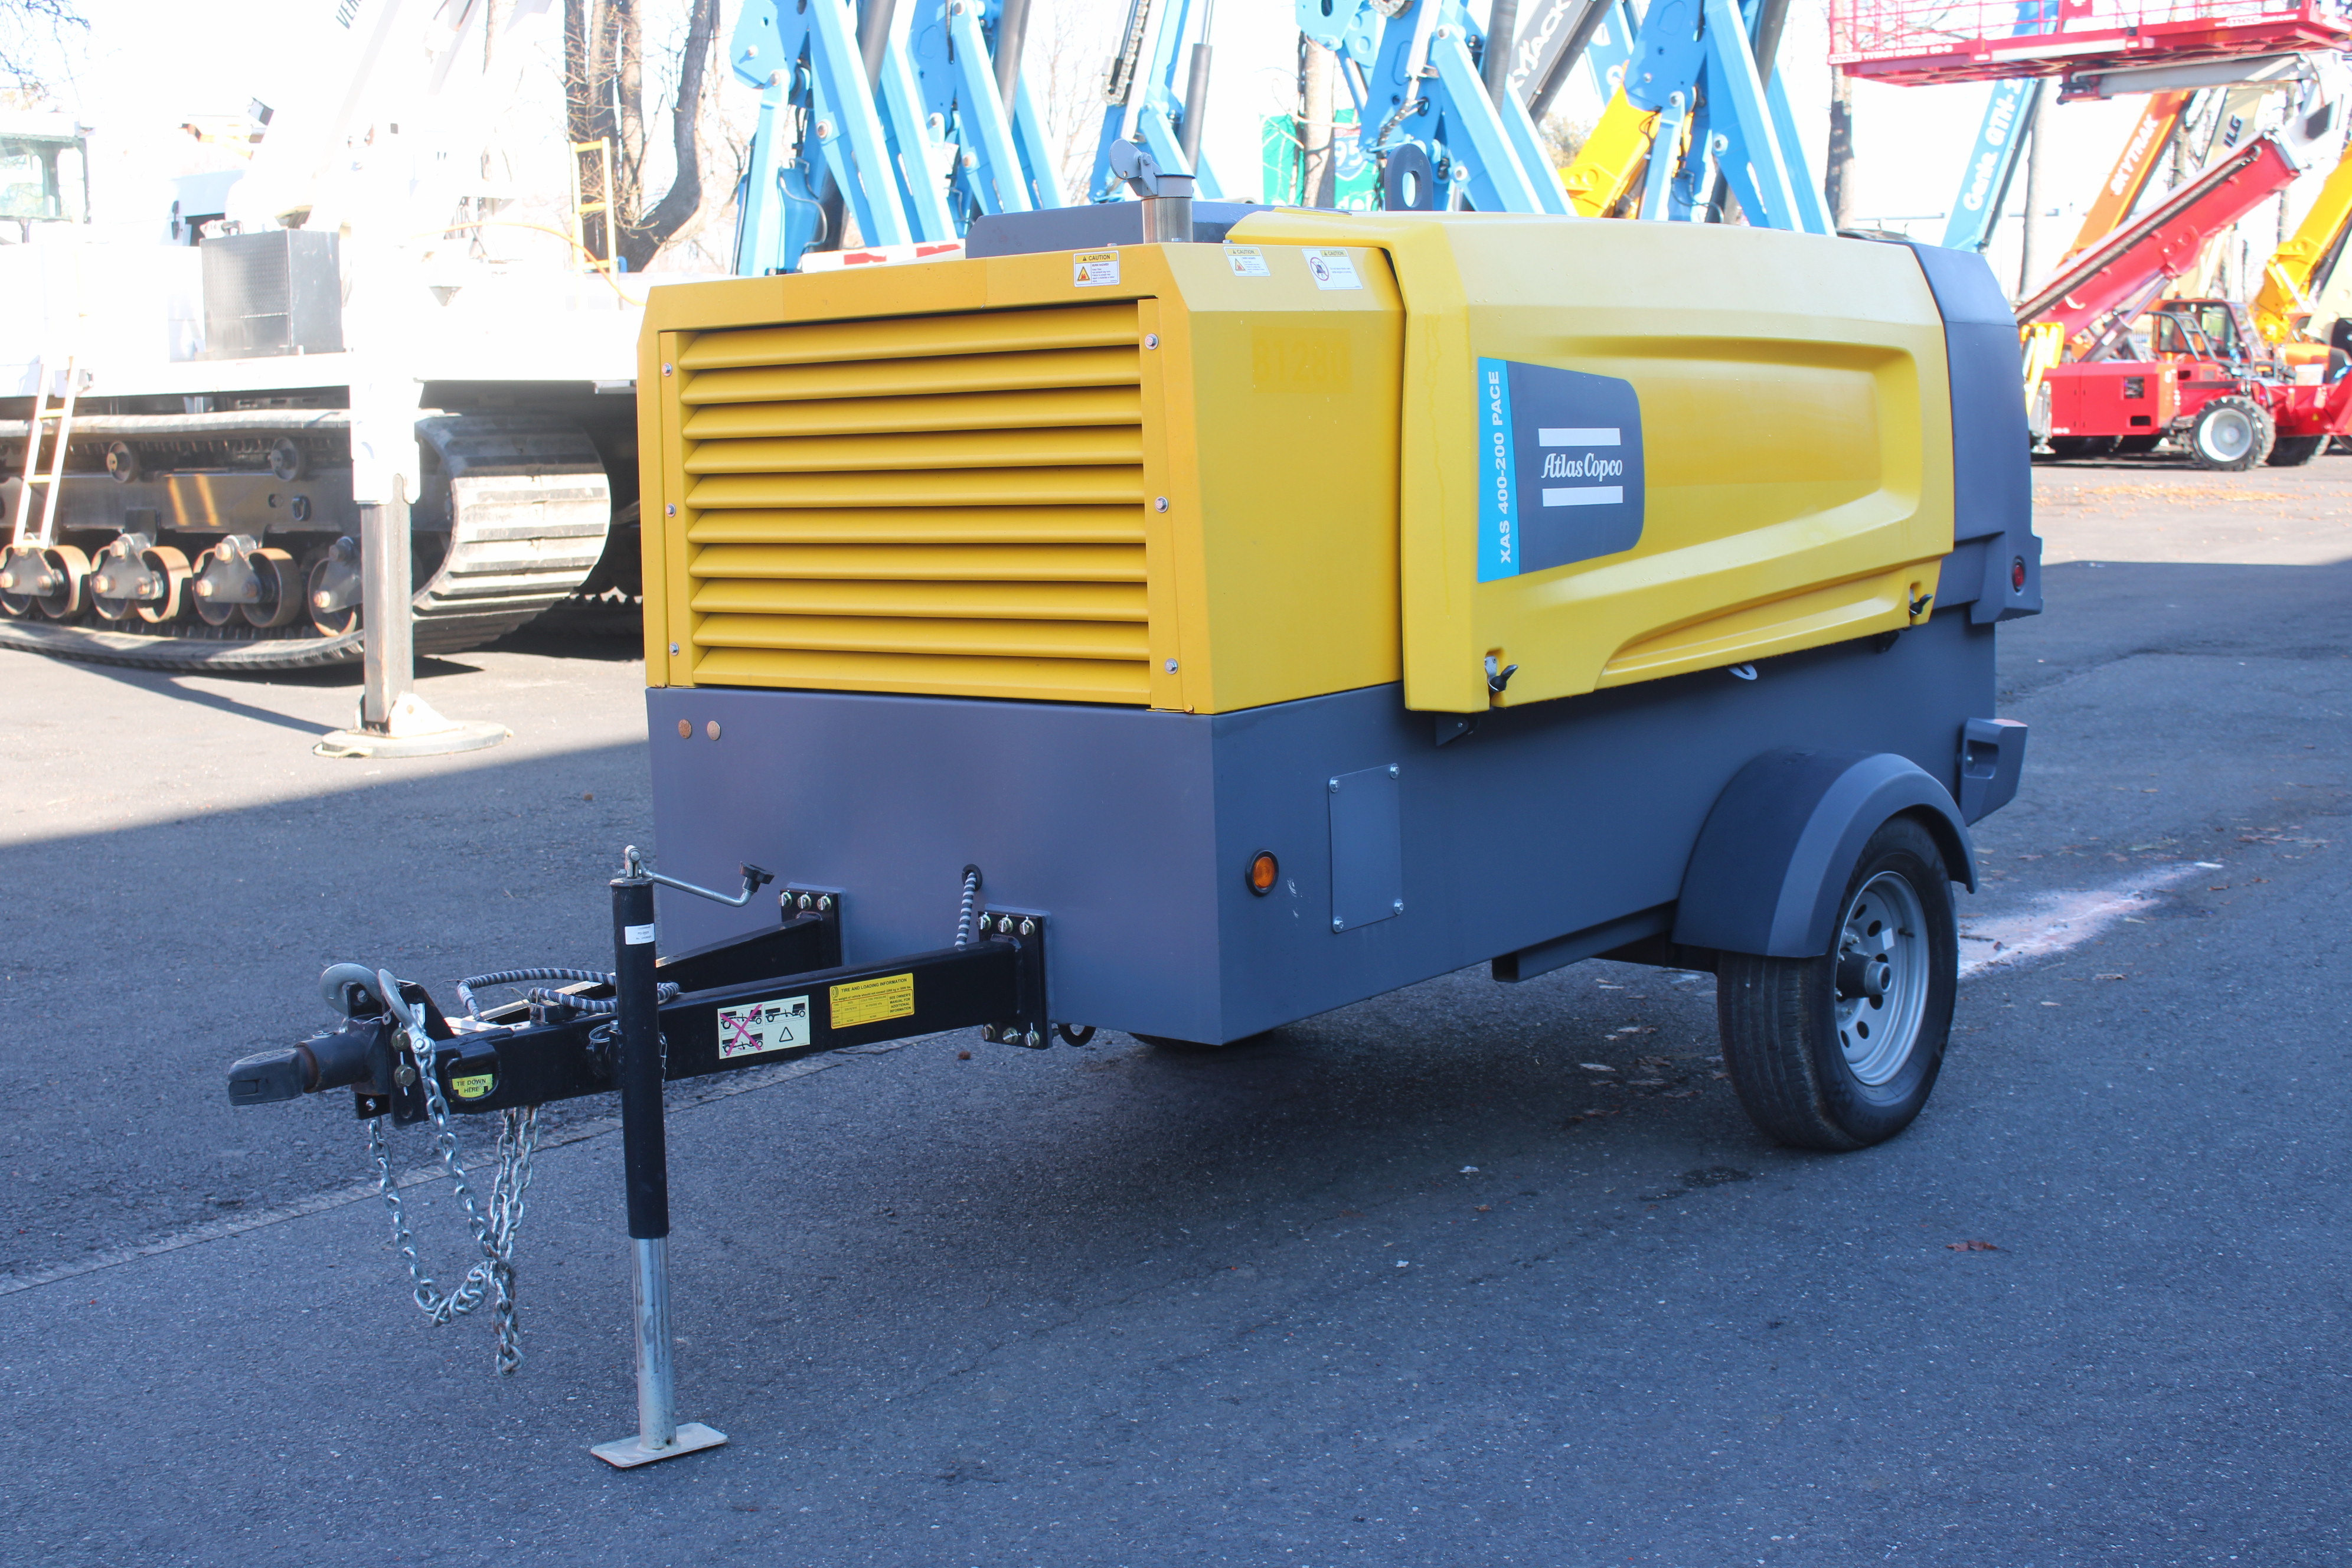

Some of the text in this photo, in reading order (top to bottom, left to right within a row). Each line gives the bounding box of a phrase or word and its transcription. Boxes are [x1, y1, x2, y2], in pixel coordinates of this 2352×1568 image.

[335, 0, 361, 30] VER
[1507, 0, 1572, 90] KYJACK
[1985, 79, 2024, 146] GTH-1
[1488, 371, 1511, 564] XAS 400-200 PACE
[1541, 453, 1623, 482] Atlas Copco
[880, 978, 907, 986] INFORMATION
